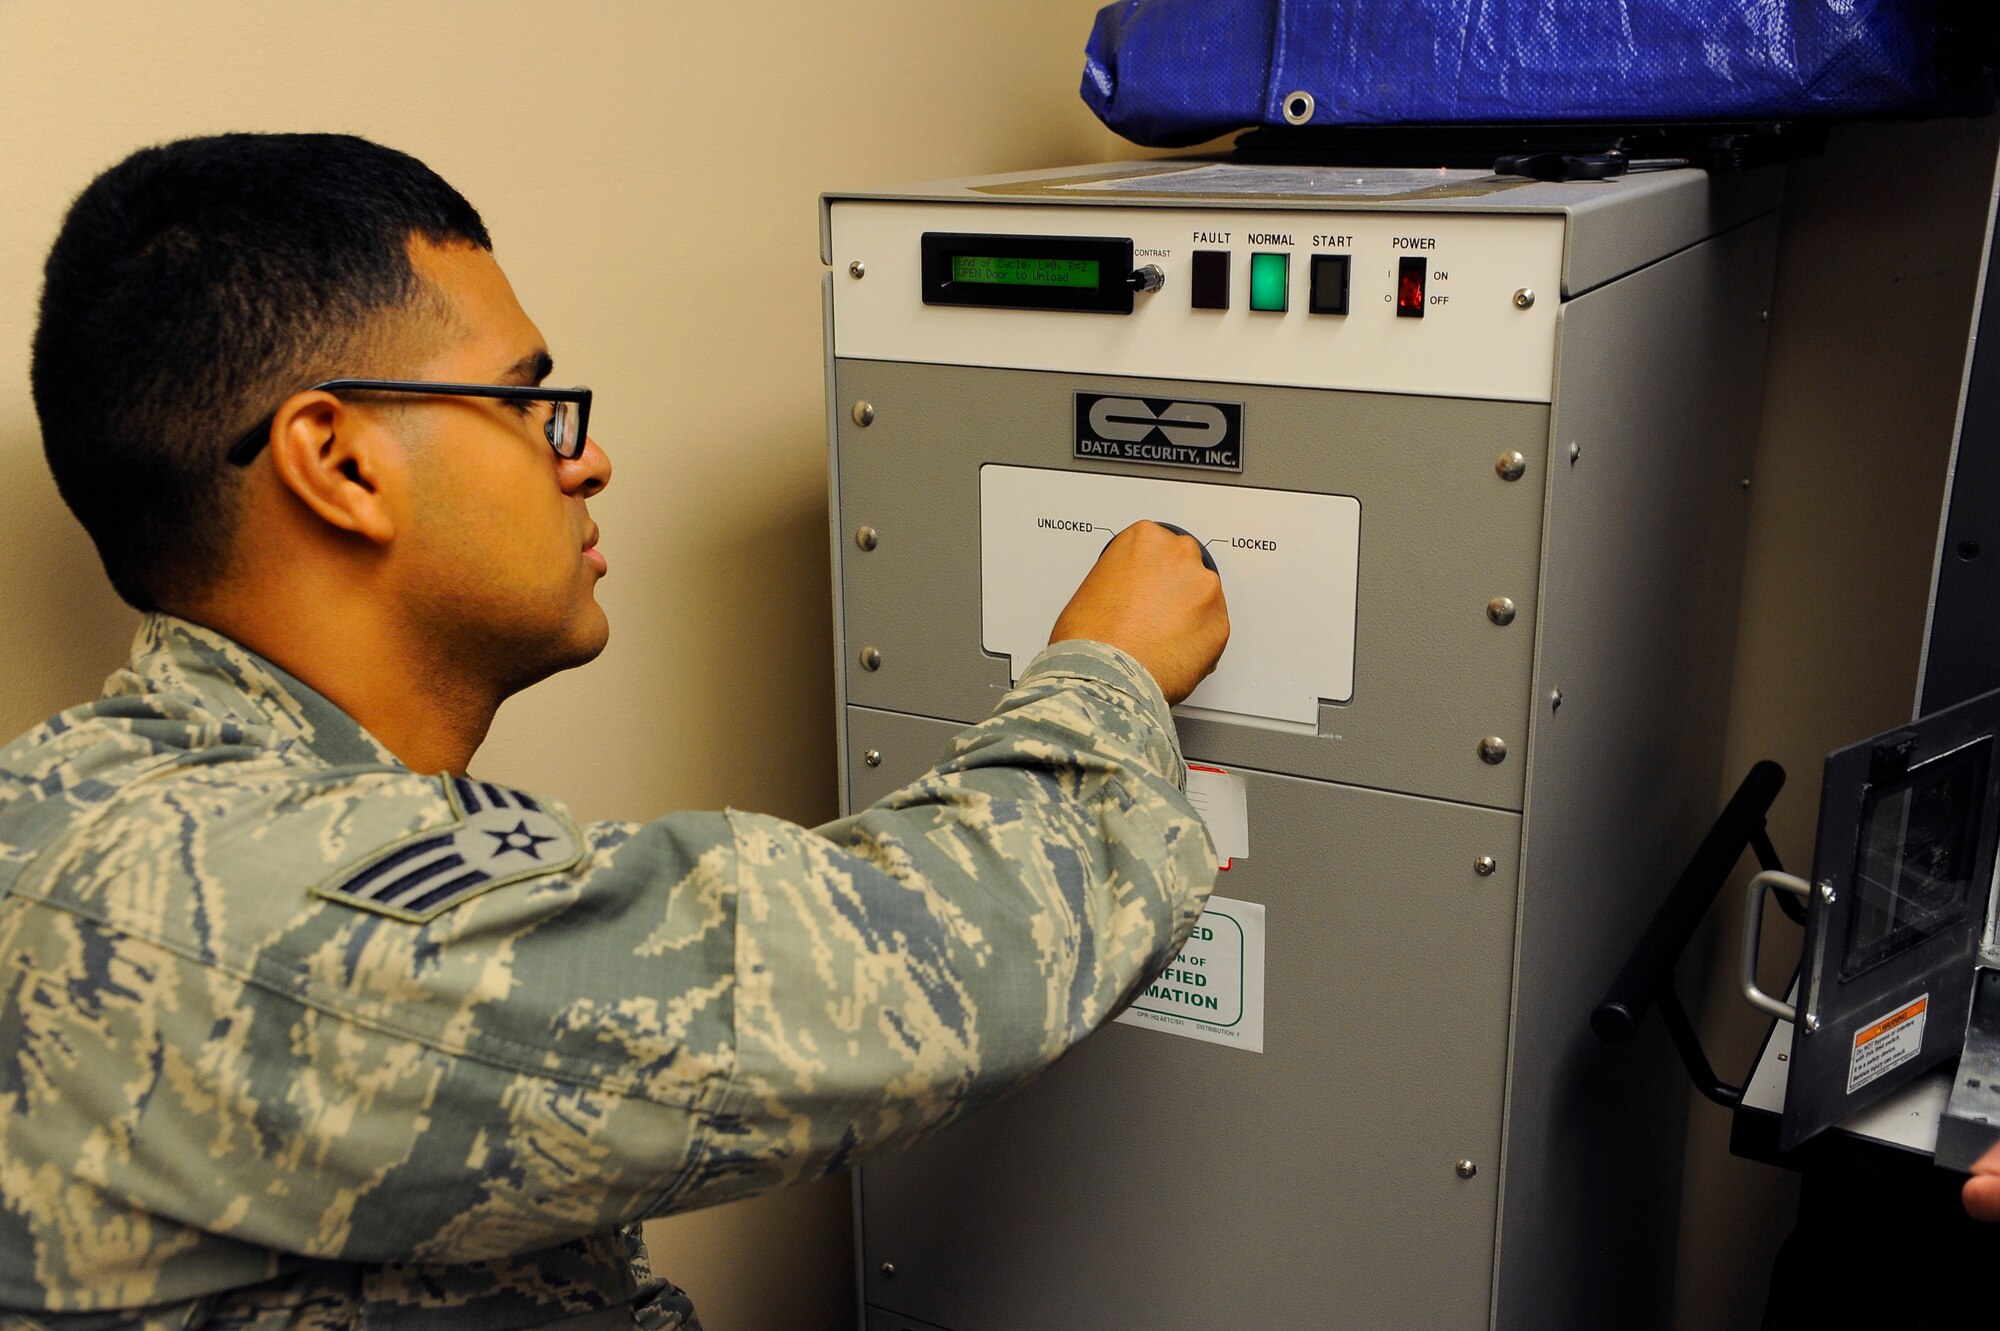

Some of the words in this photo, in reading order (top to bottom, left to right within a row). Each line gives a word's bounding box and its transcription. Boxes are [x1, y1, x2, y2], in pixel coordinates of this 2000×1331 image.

[1193, 232, 1231, 244] FAULT
[1248, 234, 1295, 246] NORMAL
[1312, 235, 1353, 247] START
[1392, 238, 1436, 250] POWER
[1135, 249, 1170, 257] CONTRAST
[981, 259, 991, 268] of
[958, 268, 981, 278] OPEN
[986, 268, 1009, 279] Door
[1016, 270, 1027, 280] to
[1033, 271, 1069, 282] Unload
[1433, 272, 1448, 280] ON
[1430, 297, 1449, 305] OFF
[1081, 440, 1120, 455] DATA
[1124, 443, 1200, 464] SECURITY,
[1205, 451, 1236, 465] INC.
[1037, 518, 1093, 533] UNLOCKED
[1232, 537, 1277, 551] LOCKED
[1190, 926, 1213, 941] ED
[1190, 956, 1206, 966] OF
[1160, 968, 1207, 987] FIED
[1144, 986, 1217, 1010] MATION
